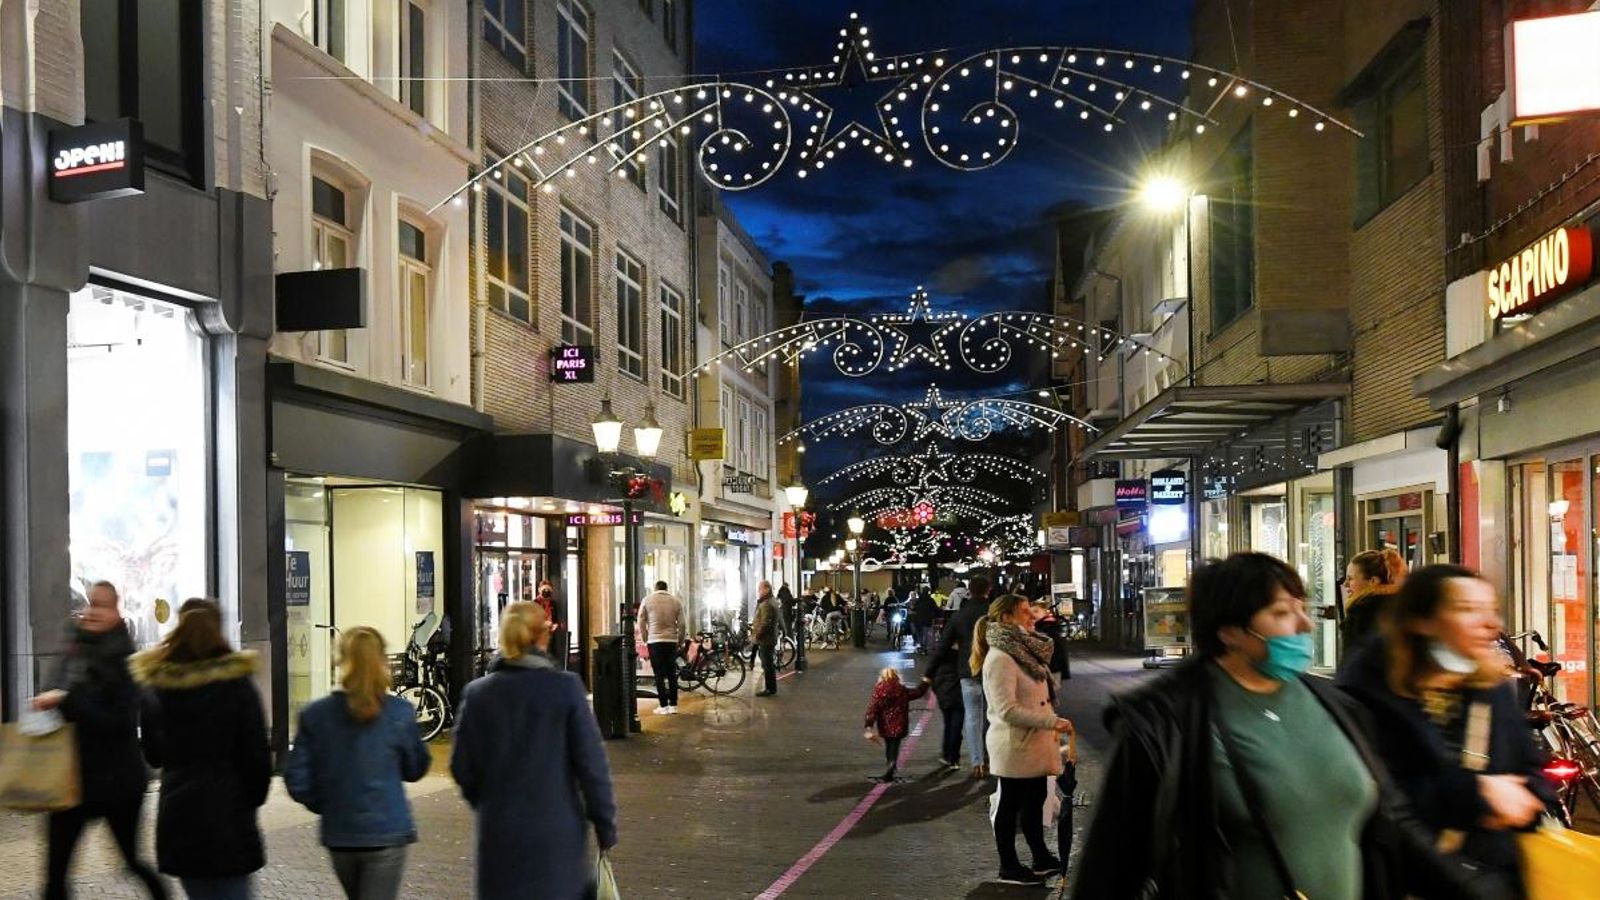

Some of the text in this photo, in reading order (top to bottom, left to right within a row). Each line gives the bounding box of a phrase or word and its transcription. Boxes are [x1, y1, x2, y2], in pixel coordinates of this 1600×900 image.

[1488, 227, 1569, 320] SCAPINO
[563, 348, 579, 358] ICI
[556, 359, 586, 369] PARIS
[564, 370, 577, 380] XL
[569, 516, 586, 524] ICI
[589, 514, 622, 524] PARIS
